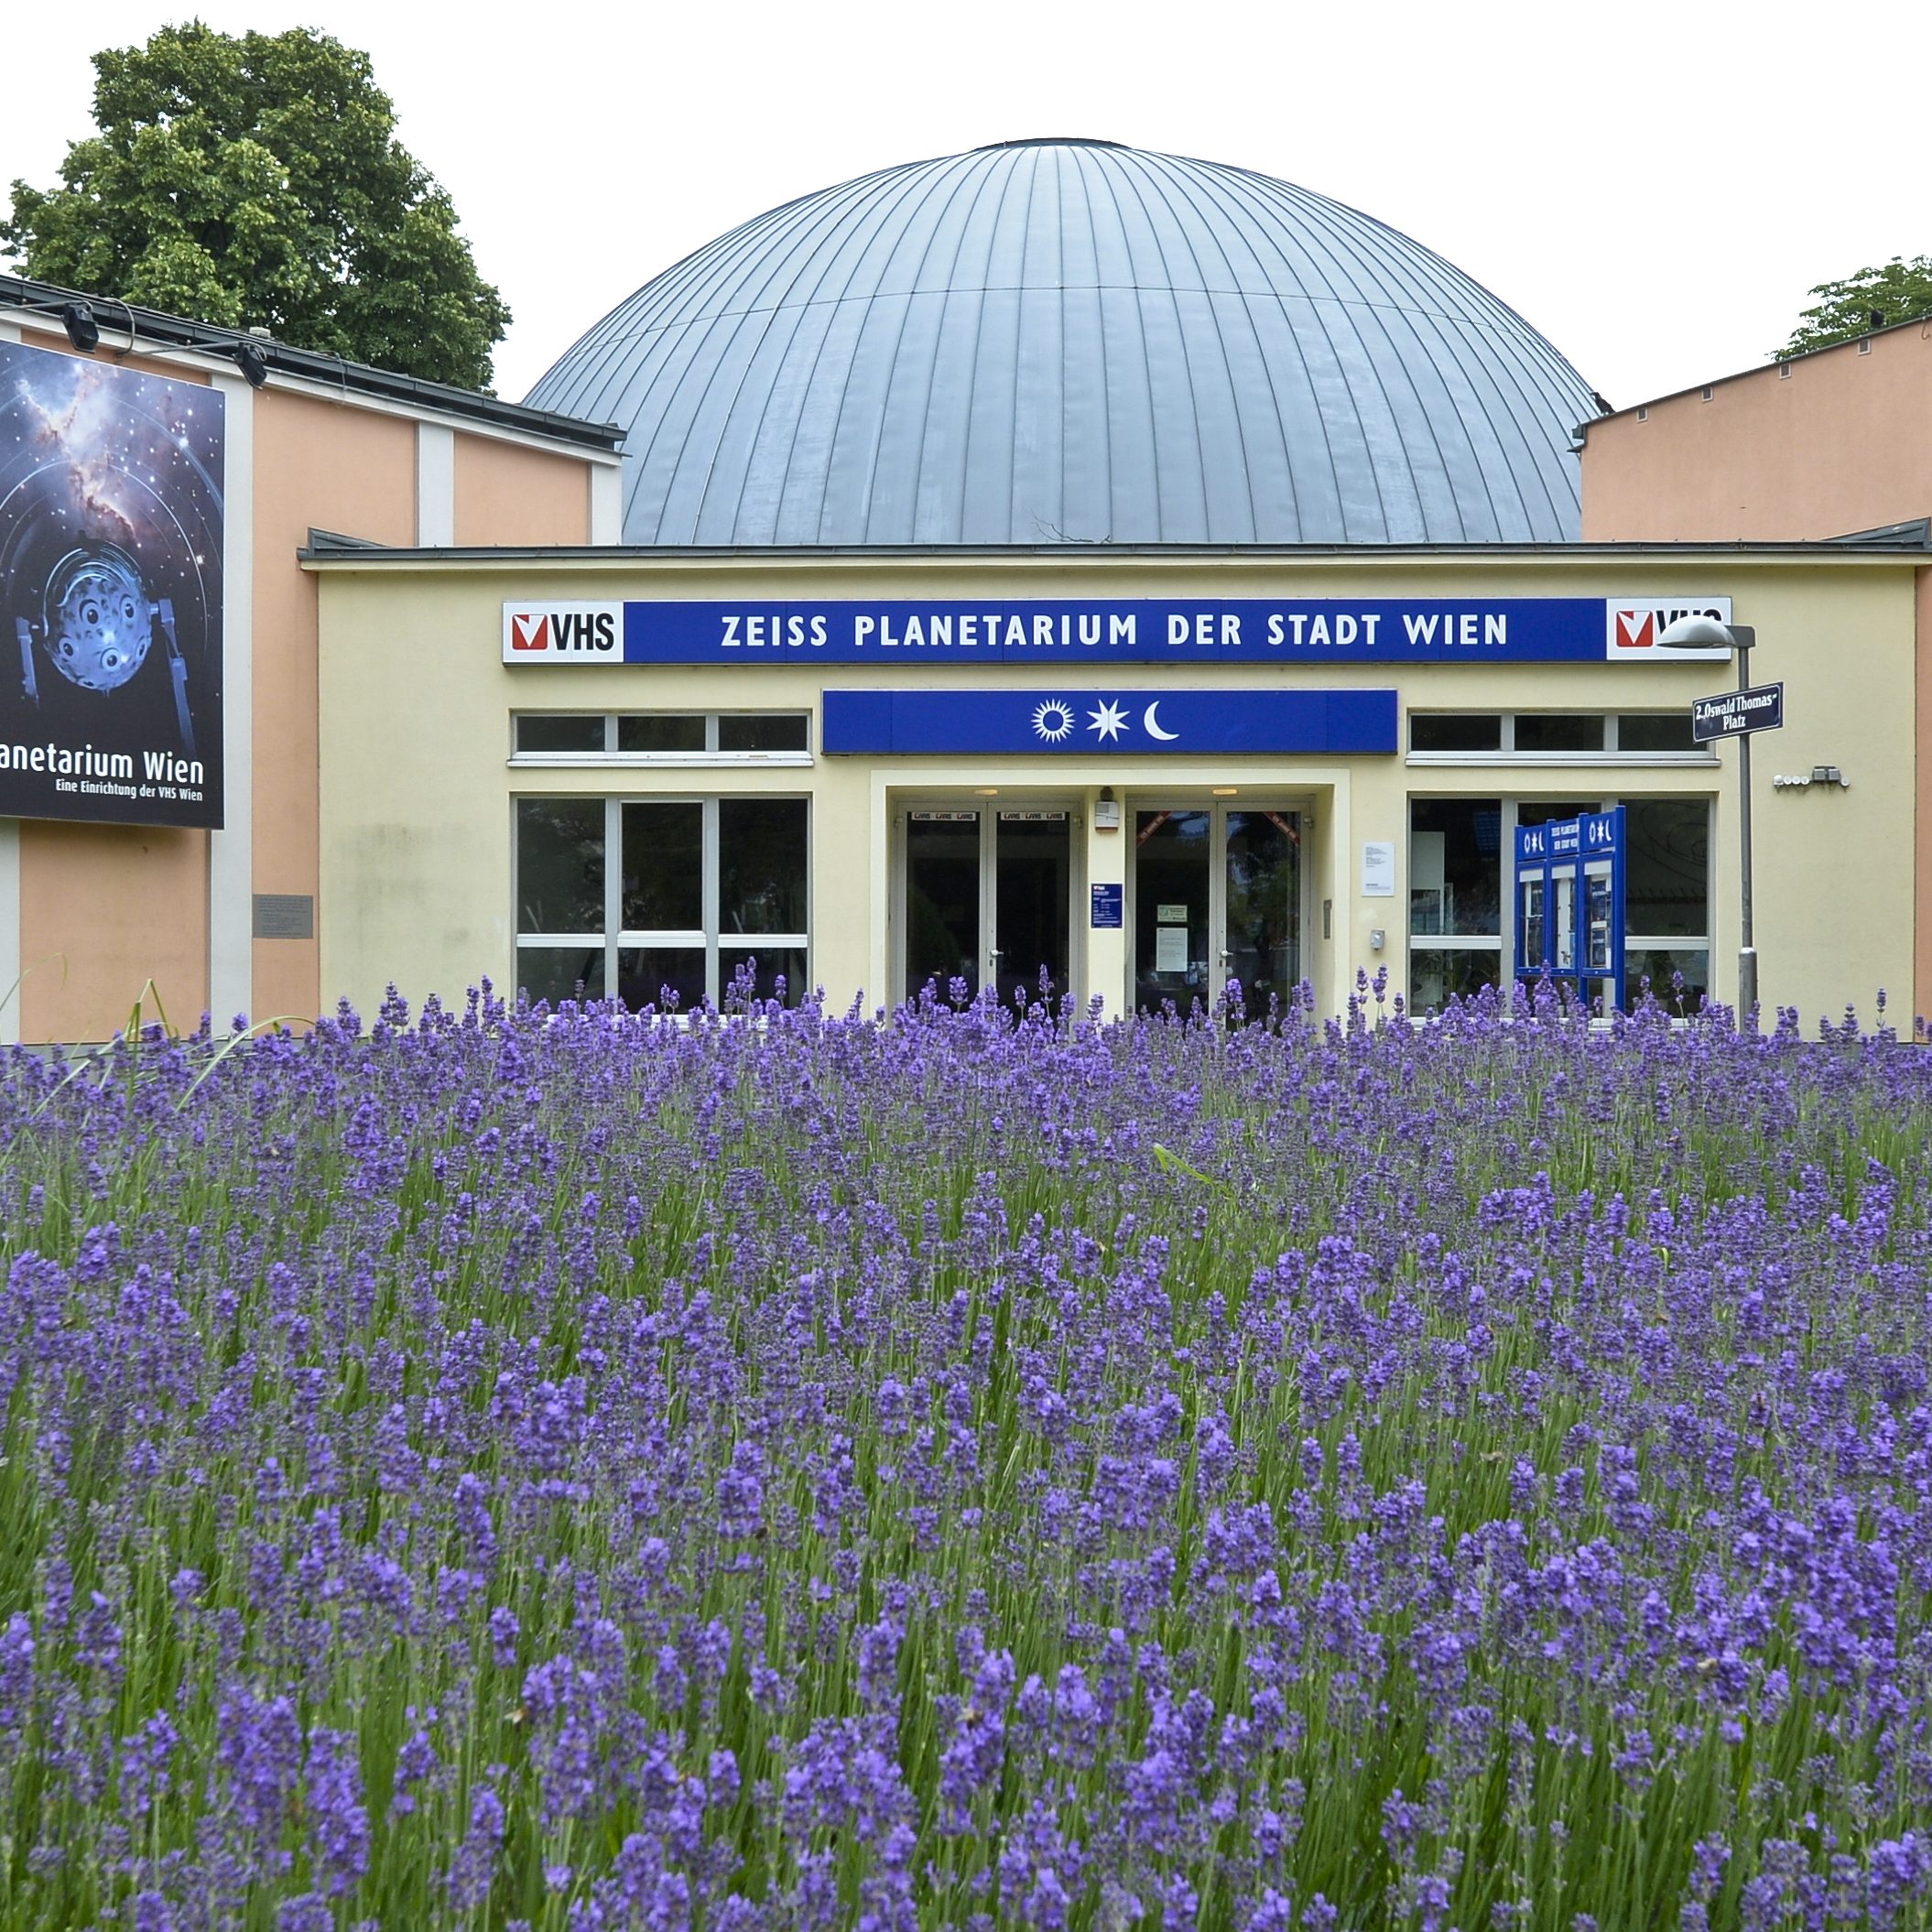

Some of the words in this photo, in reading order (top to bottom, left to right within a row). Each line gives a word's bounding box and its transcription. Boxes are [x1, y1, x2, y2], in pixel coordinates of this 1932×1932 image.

[550, 613, 614, 651] VHS
[721, 615, 828, 646] ZEISS
[854, 614, 1136, 646] PLANETARIUM
[1167, 614, 1242, 646] DER
[1267, 613, 1381, 646] STADT
[1402, 613, 1506, 645] WIEN
[1704, 698, 1735, 718] Oswald
[1722, 714, 1746, 731] Platz
[143, 751, 203, 785] Wien
[56, 778, 78, 793] Eine
[80, 780, 137, 799] Einrichtung
[139, 783, 156, 798] der
[157, 786, 177, 799] VHS
[179, 787, 203, 802] Wien
